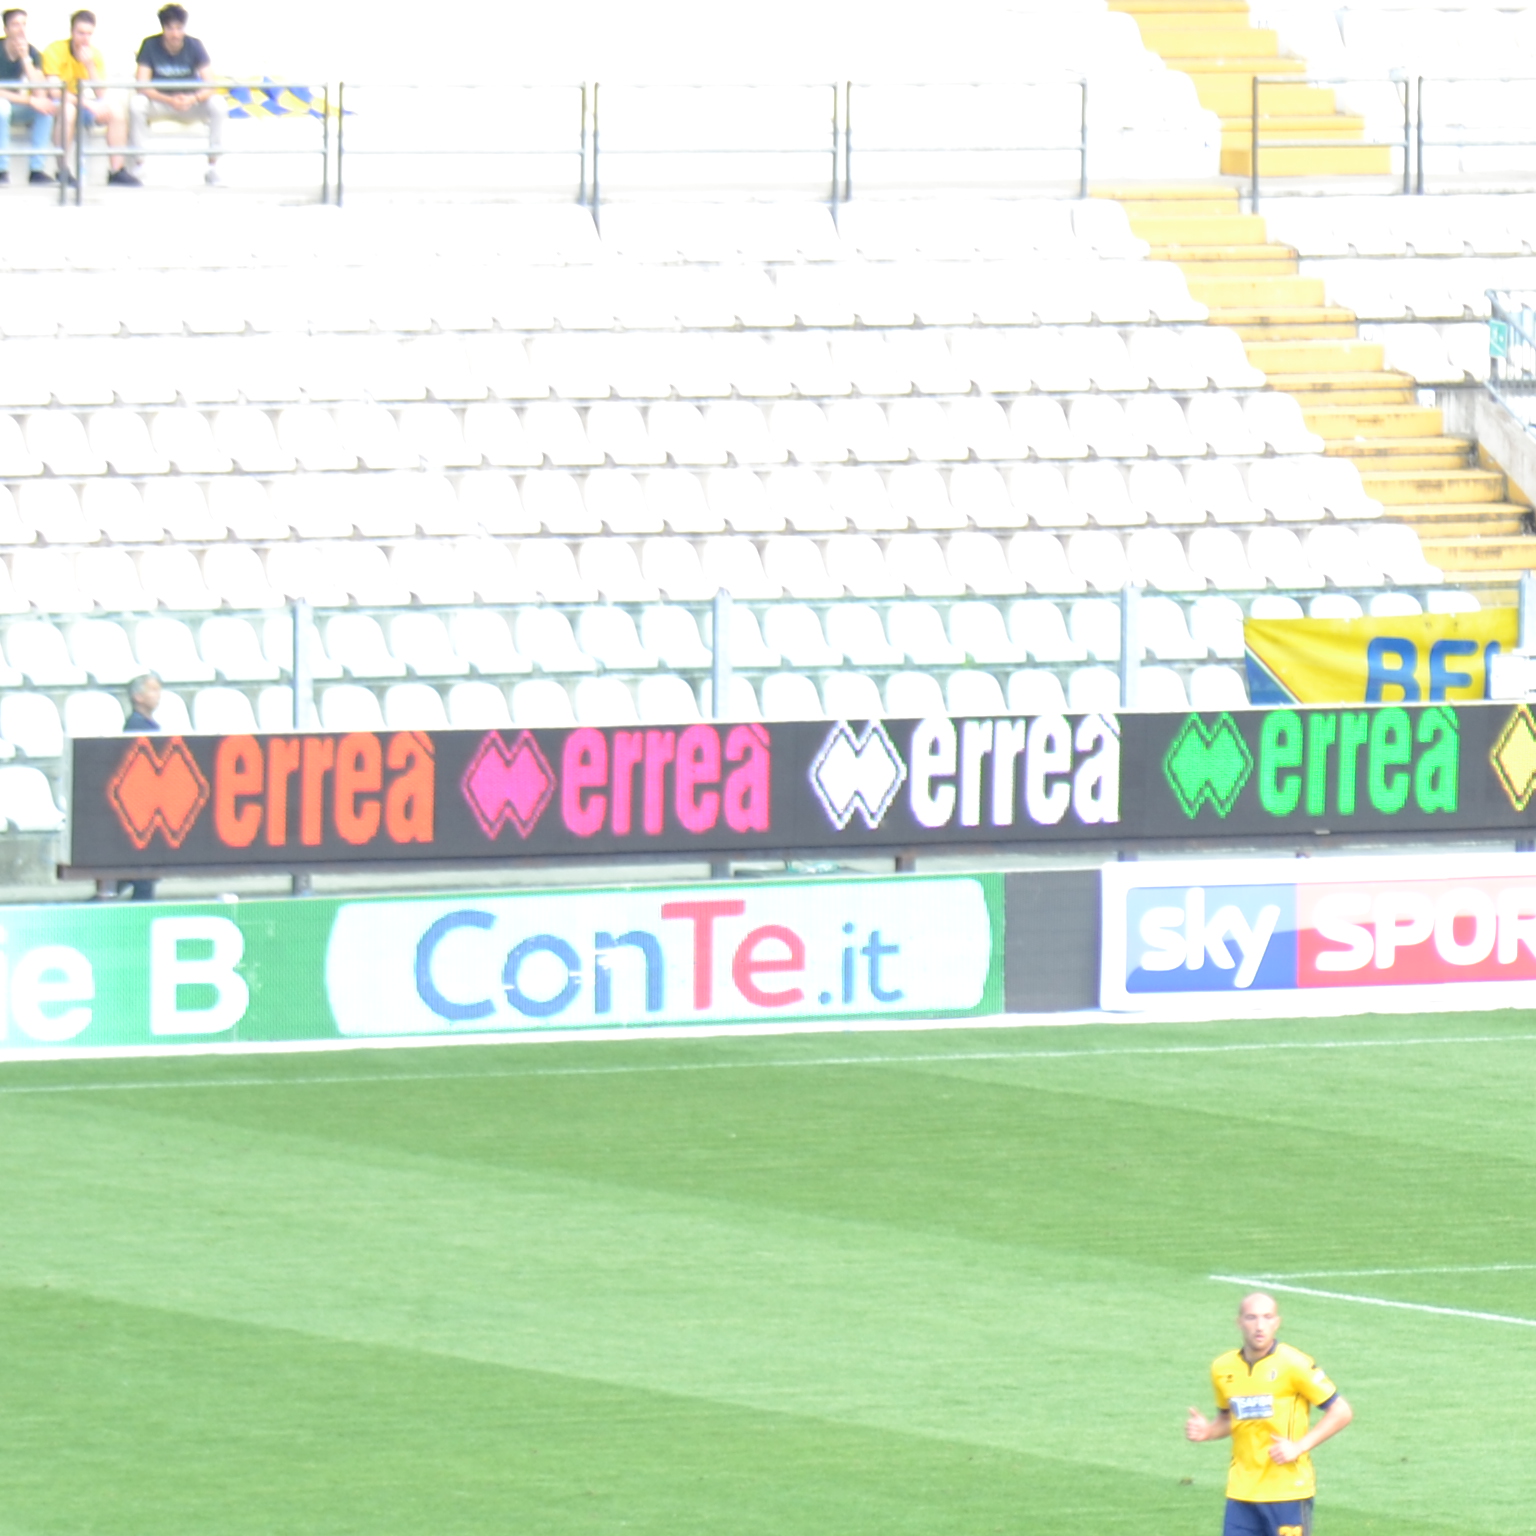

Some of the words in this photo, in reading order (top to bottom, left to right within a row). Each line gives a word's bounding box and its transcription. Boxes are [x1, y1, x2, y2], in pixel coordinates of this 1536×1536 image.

[0, 924, 95, 1042] e
[150, 914, 250, 1037] B
[414, 898, 903, 1020] ConTe.it
[1138, 886, 1281, 988] sky
